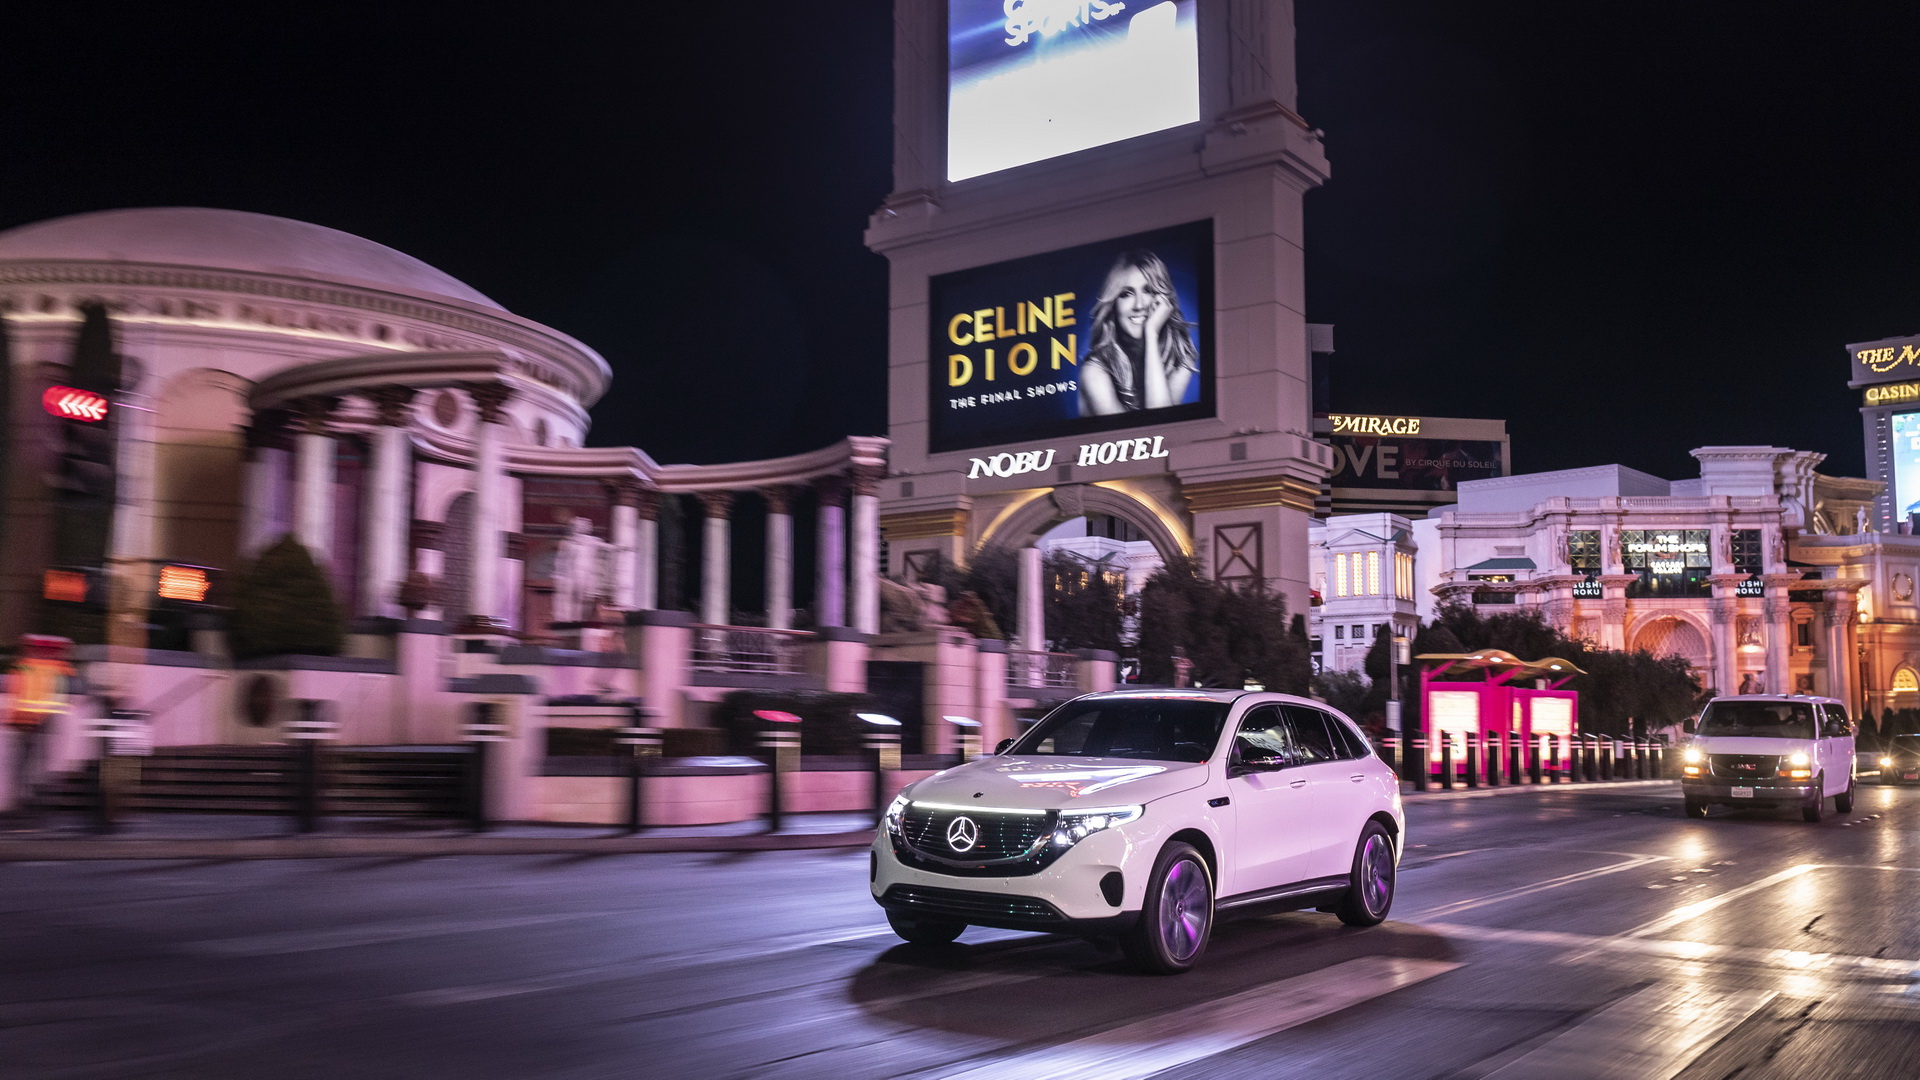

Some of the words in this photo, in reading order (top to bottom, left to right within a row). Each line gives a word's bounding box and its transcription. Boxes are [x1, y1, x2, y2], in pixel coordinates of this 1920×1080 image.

[948, 292, 1077, 347] CELINE
[948, 333, 1077, 388] DION
[1857, 347, 1895, 364] THE
[949, 396, 976, 410] THE
[980, 389, 1022, 405] FINAL
[1027, 380, 1077, 398] SHOWS
[1866, 383, 1920, 401] CASIN
[1333, 416, 1420, 436] MIRAGE
[967, 449, 1056, 479] NOBU
[1077, 436, 1169, 466] HOTEL
[1418, 459, 1451, 470] CIRQUE
[1453, 460, 1466, 468] DU
[1467, 460, 1497, 469] SOLEIL
[1628, 543, 1666, 553] FORUM
[1667, 543, 1708, 553] SHOPS
[1656, 535, 1680, 544] THE
[1573, 588, 1601, 596] ROKU
[1735, 587, 1761, 595] ROKU
[1737, 580, 1764, 588] USHI
